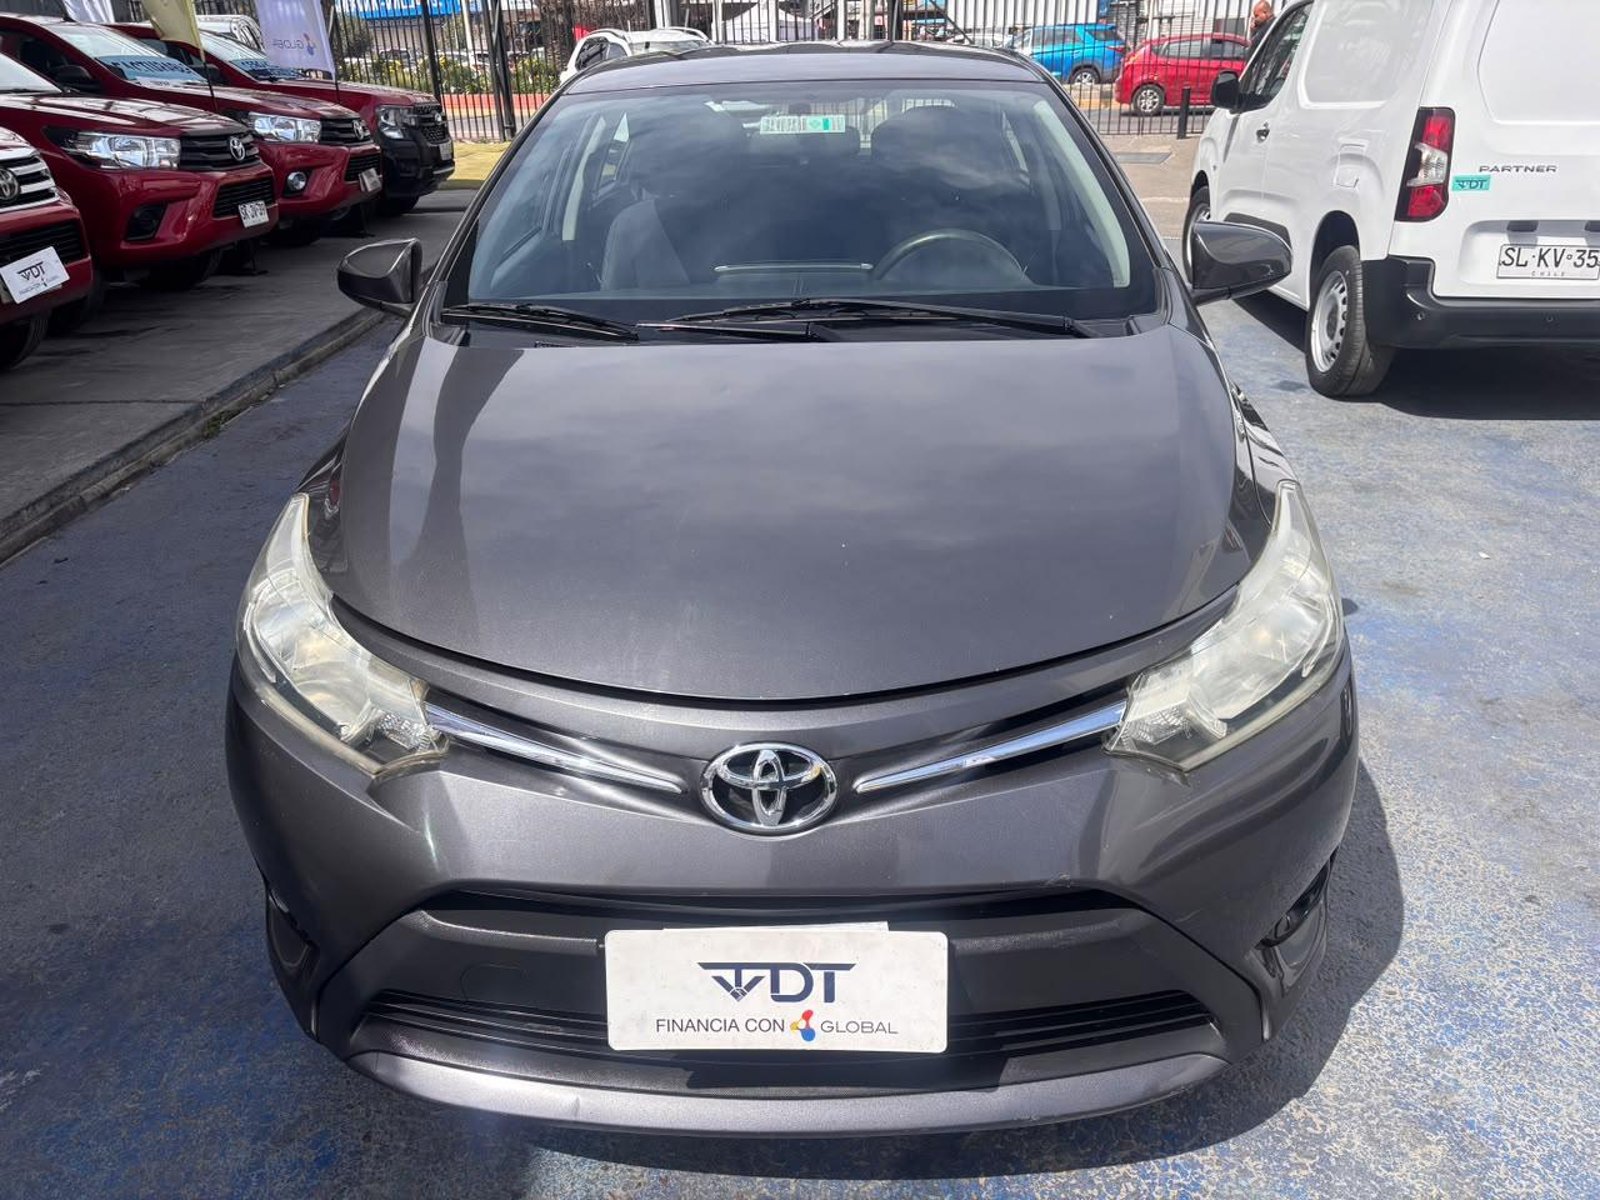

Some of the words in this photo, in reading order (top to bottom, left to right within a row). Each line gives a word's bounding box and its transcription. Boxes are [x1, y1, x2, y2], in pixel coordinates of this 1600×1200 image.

[1479, 165, 1557, 173] PARTNER
[656, 1018, 740, 1033] FINANCIA
[745, 1018, 785, 1033] CON
[820, 1020, 899, 1035] GLOBAL
